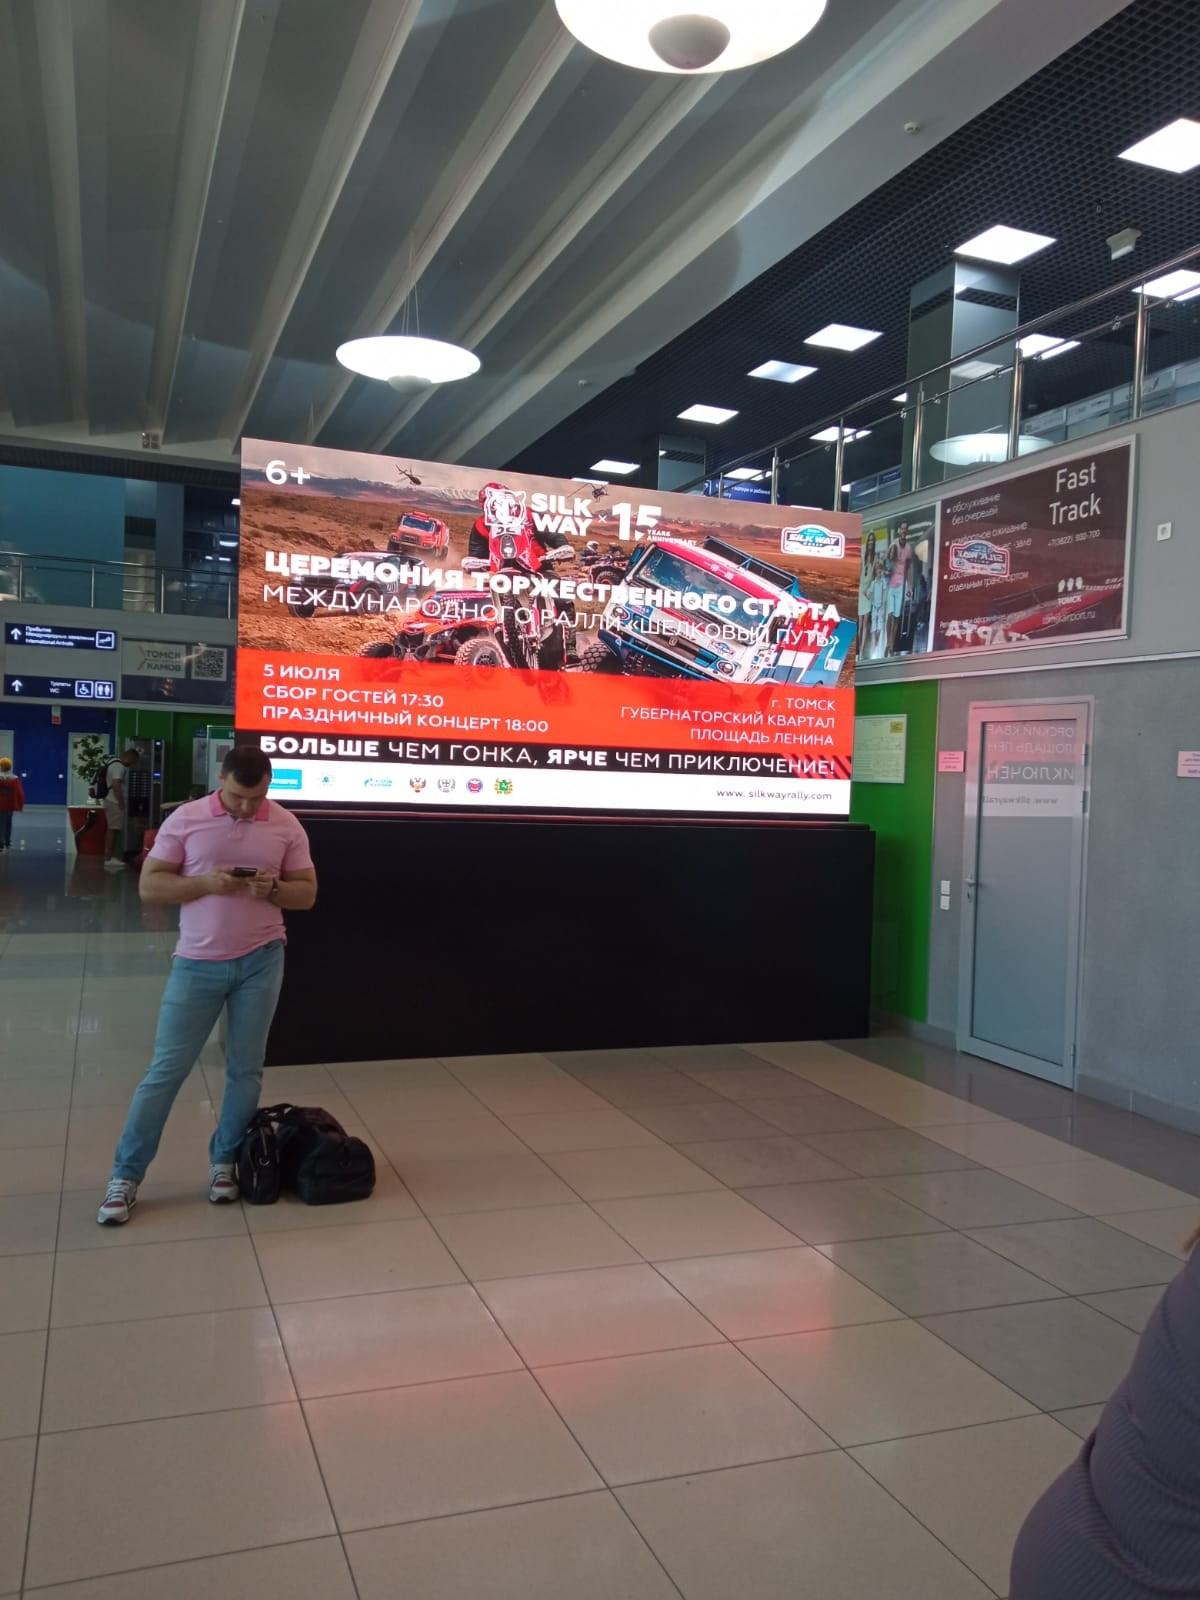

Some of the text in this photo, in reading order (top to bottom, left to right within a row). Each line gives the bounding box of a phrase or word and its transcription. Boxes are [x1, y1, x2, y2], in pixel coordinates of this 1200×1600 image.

[266, 460, 310, 485] 6+
[1056, 462, 1096, 493] Fast
[531, 492, 593, 518] SILK
[1049, 493, 1101, 525] Track
[532, 511, 590, 536] WAY
[612, 502, 662, 540] 15
[788, 533, 813, 542] SILK
[815, 535, 837, 545] WAY
[265, 551, 839, 621] ЦЕРЕМОНИЯ ТОРЖЕСТВЕННОГО СТАРТА
[263, 584, 530, 624] МЕЖДУНАРОДНОГО
[541, 611, 620, 632] РАЛЛИ
[776, 627, 840, 647] ПУТЬ»
[263, 663, 341, 681] 5 ИЮЛЯ
[262, 684, 444, 708] СБОР ГОСТЕЙ 17:30
[771, 697, 836, 711] г. ТОМСК
[262, 705, 549, 733] ПРАЗДНИЧНЫЙ КОНЦЕРТ 18:00
[621, 706, 836, 729] ГУБЕРНАТОРСКИЙ КВАРТАЛ
[690, 728, 834, 747] ПЛОЩАДЬ ЛЕНИНА
[260, 735, 835, 775] БОЛЬШЕ ЧЕМ ГОНКА, ЯРЧЕ ЧЕМ ПРИКЛЮЧЕНИЕ!
